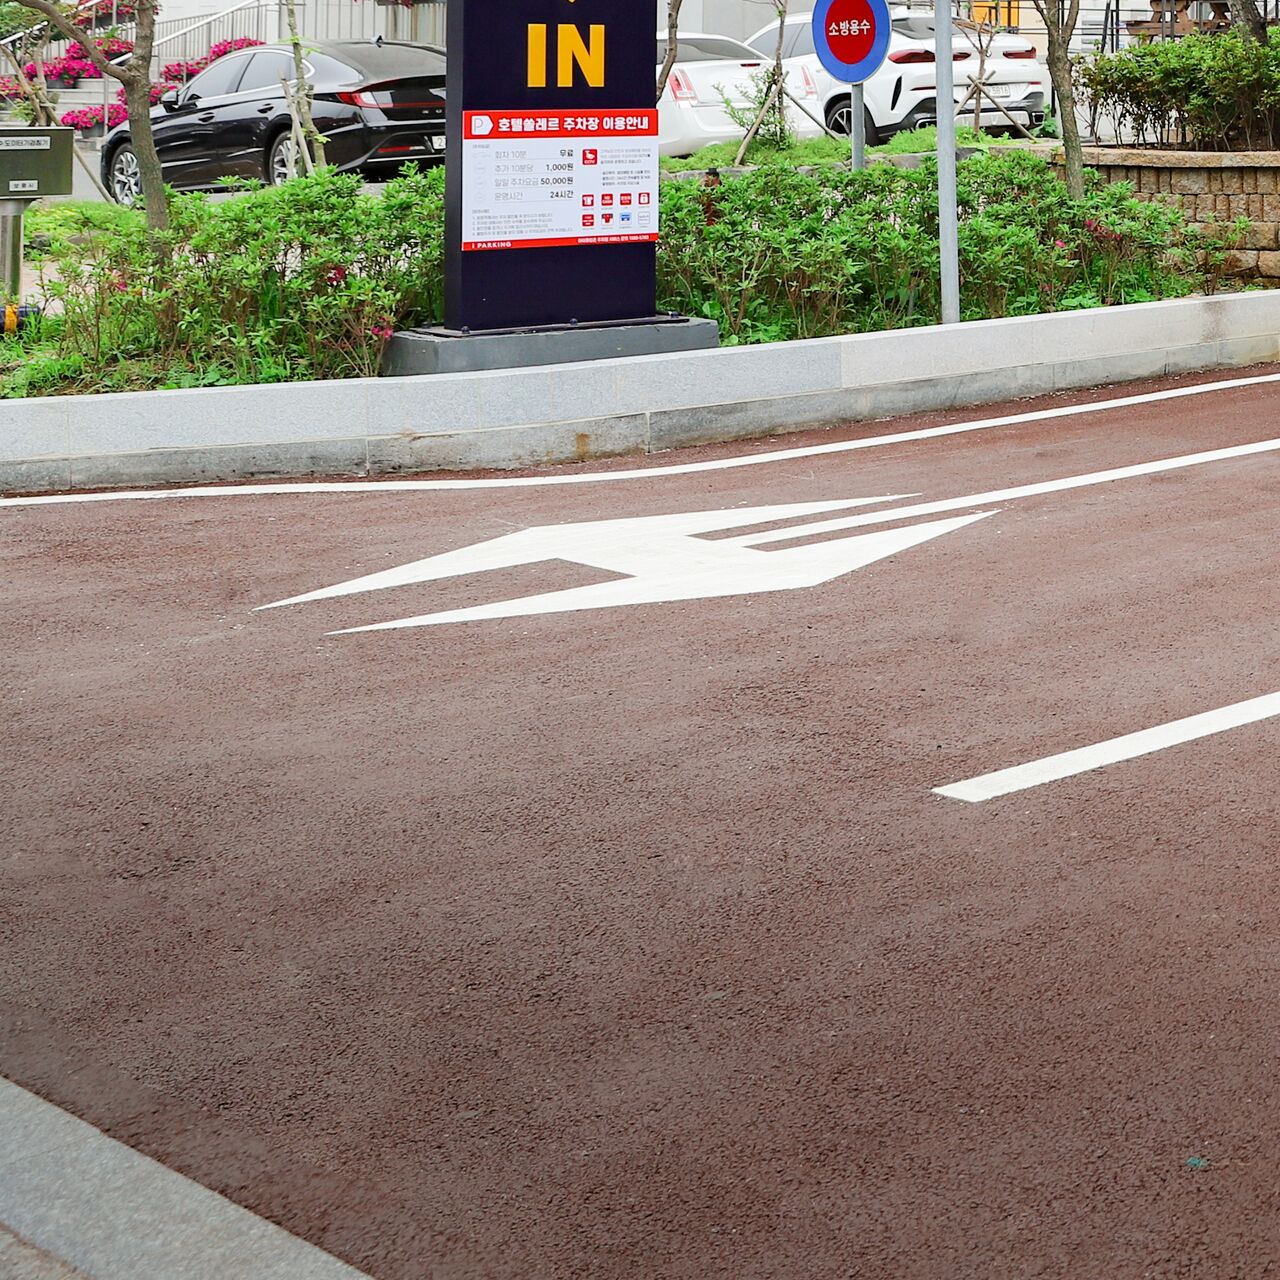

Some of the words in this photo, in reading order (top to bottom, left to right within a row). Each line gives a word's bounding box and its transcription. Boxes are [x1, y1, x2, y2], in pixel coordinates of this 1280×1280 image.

[828, 18, 871, 36] 소방용수
[527, 23, 606, 88] IN
[563, 116, 600, 131] 주차장
[602, 116, 650, 131] 이용안내
[546, 162, 574, 172] 1,000원
[540, 176, 574, 186] 50,000원
[549, 189, 574, 199] 24시간
[477, 241, 512, 249] PARKING
